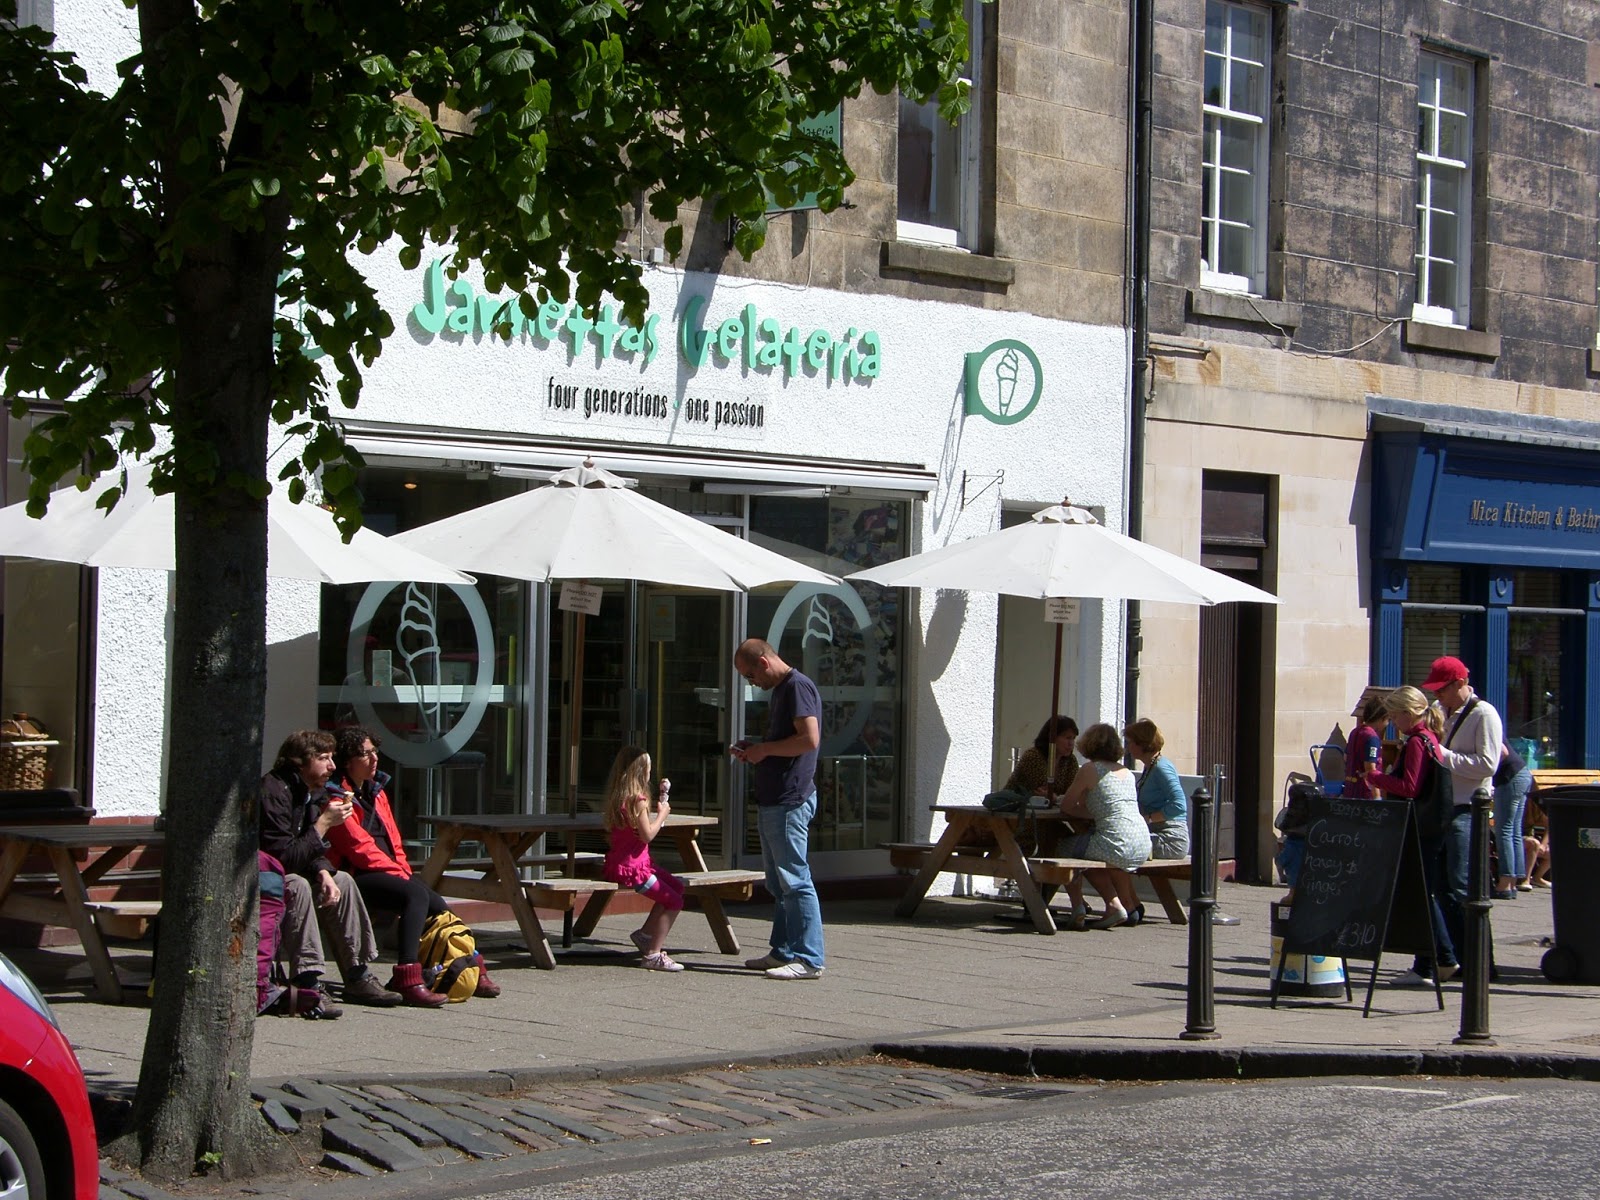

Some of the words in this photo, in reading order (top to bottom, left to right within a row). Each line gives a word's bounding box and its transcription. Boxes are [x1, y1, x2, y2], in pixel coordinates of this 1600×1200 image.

[802, 125, 834, 138] lateria
[682, 295, 881, 379] Gelateria
[549, 376, 579, 410] four
[584, 386, 668, 419] generations
[685, 397, 709, 422] one
[714, 396, 765, 430] passion
[1470, 499, 1499, 521] Mica
[1504, 501, 1551, 526] Kitchen
[1555, 506, 1563, 526] &
